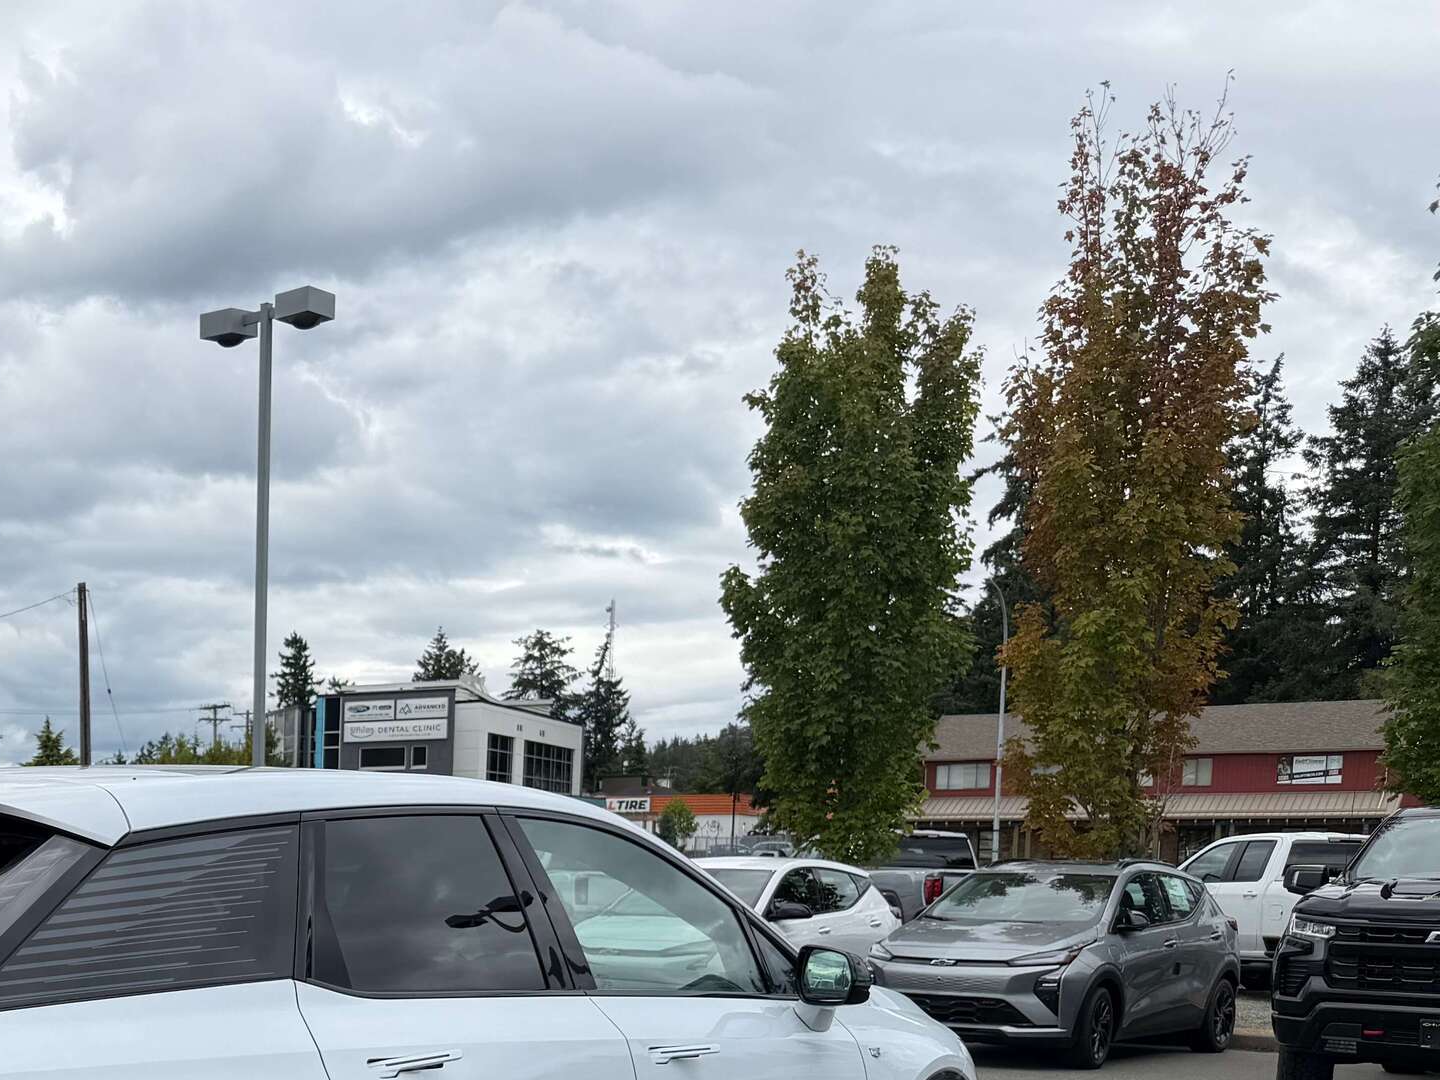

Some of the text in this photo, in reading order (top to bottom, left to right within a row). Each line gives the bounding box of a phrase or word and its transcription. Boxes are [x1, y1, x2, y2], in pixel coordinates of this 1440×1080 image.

[377, 726, 409, 734] DENTAL
[413, 724, 441, 732] CLINIC
[616, 800, 648, 810] TIRE
